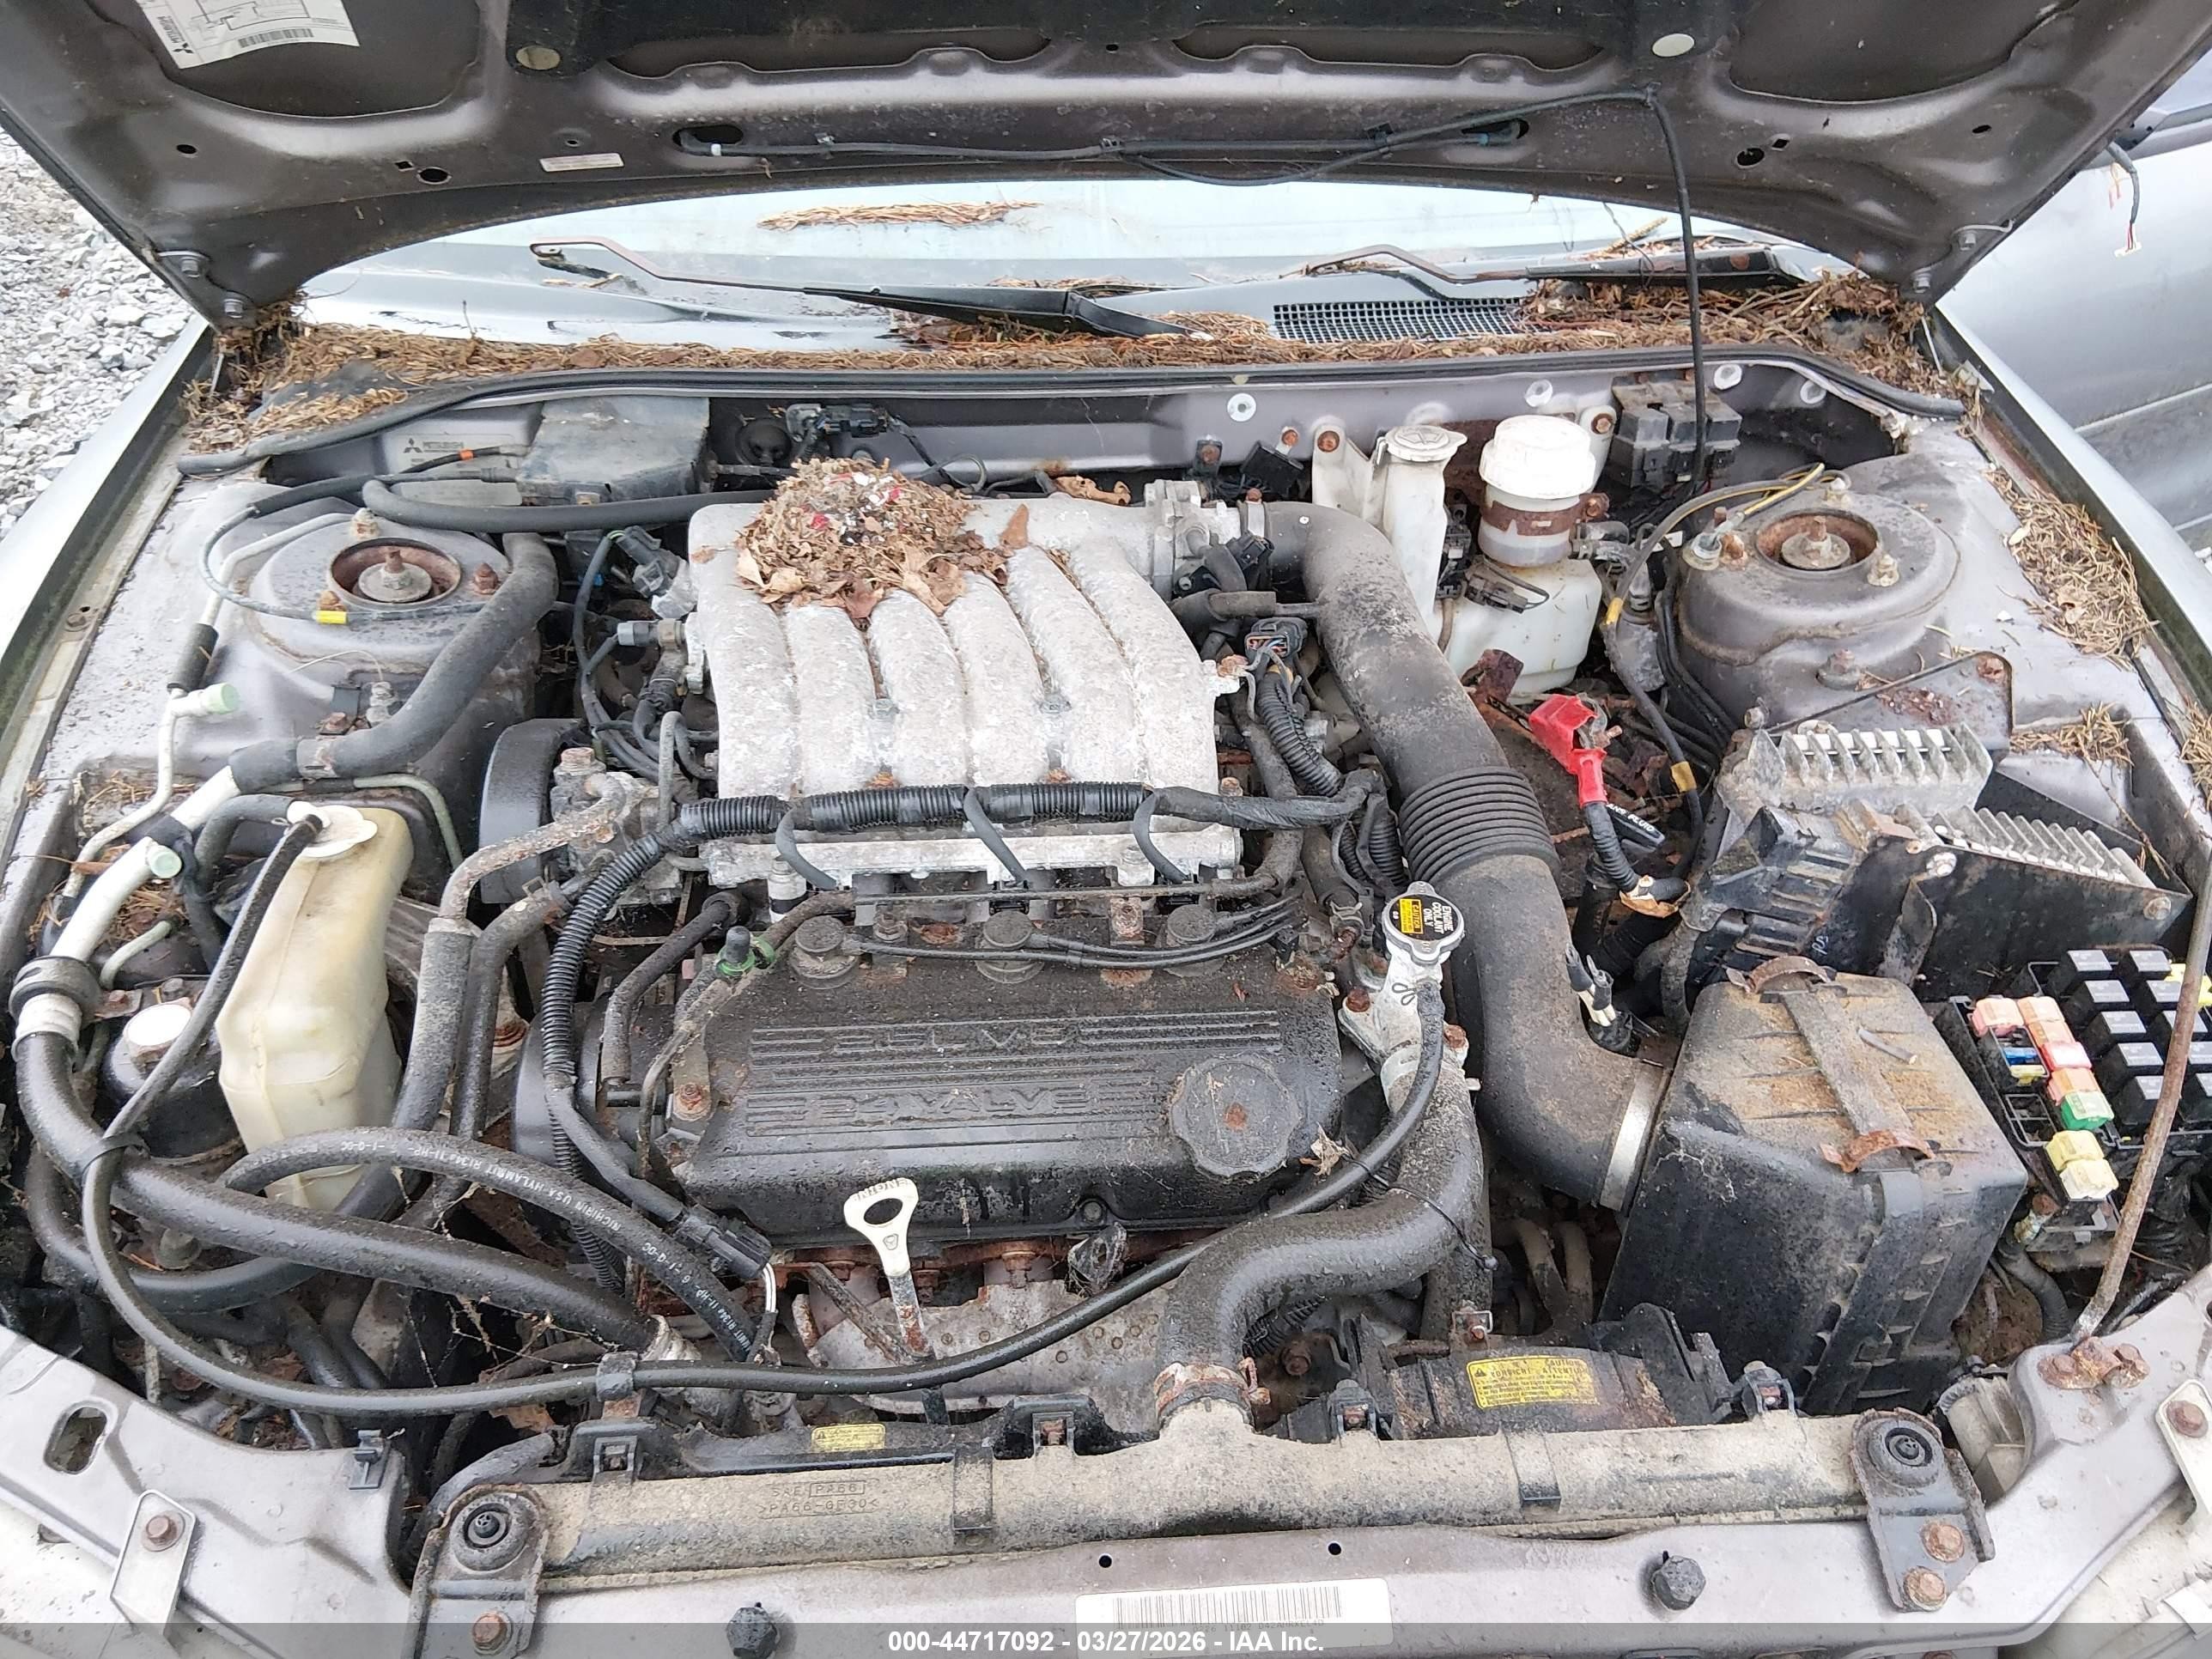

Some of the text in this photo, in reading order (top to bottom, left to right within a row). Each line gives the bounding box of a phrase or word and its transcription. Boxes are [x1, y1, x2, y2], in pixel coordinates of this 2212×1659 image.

[1627, 813, 1655, 833] FLUID
[1412, 903, 1421, 930] CAUTION
[1423, 908, 1434, 927] ONLY
[1431, 902, 1444, 934] COOLANT
[1443, 905, 1455, 932] ENGINE
[910, 1084, 1088, 1115] VALVE
[816, 1483, 858, 1495] PA66
